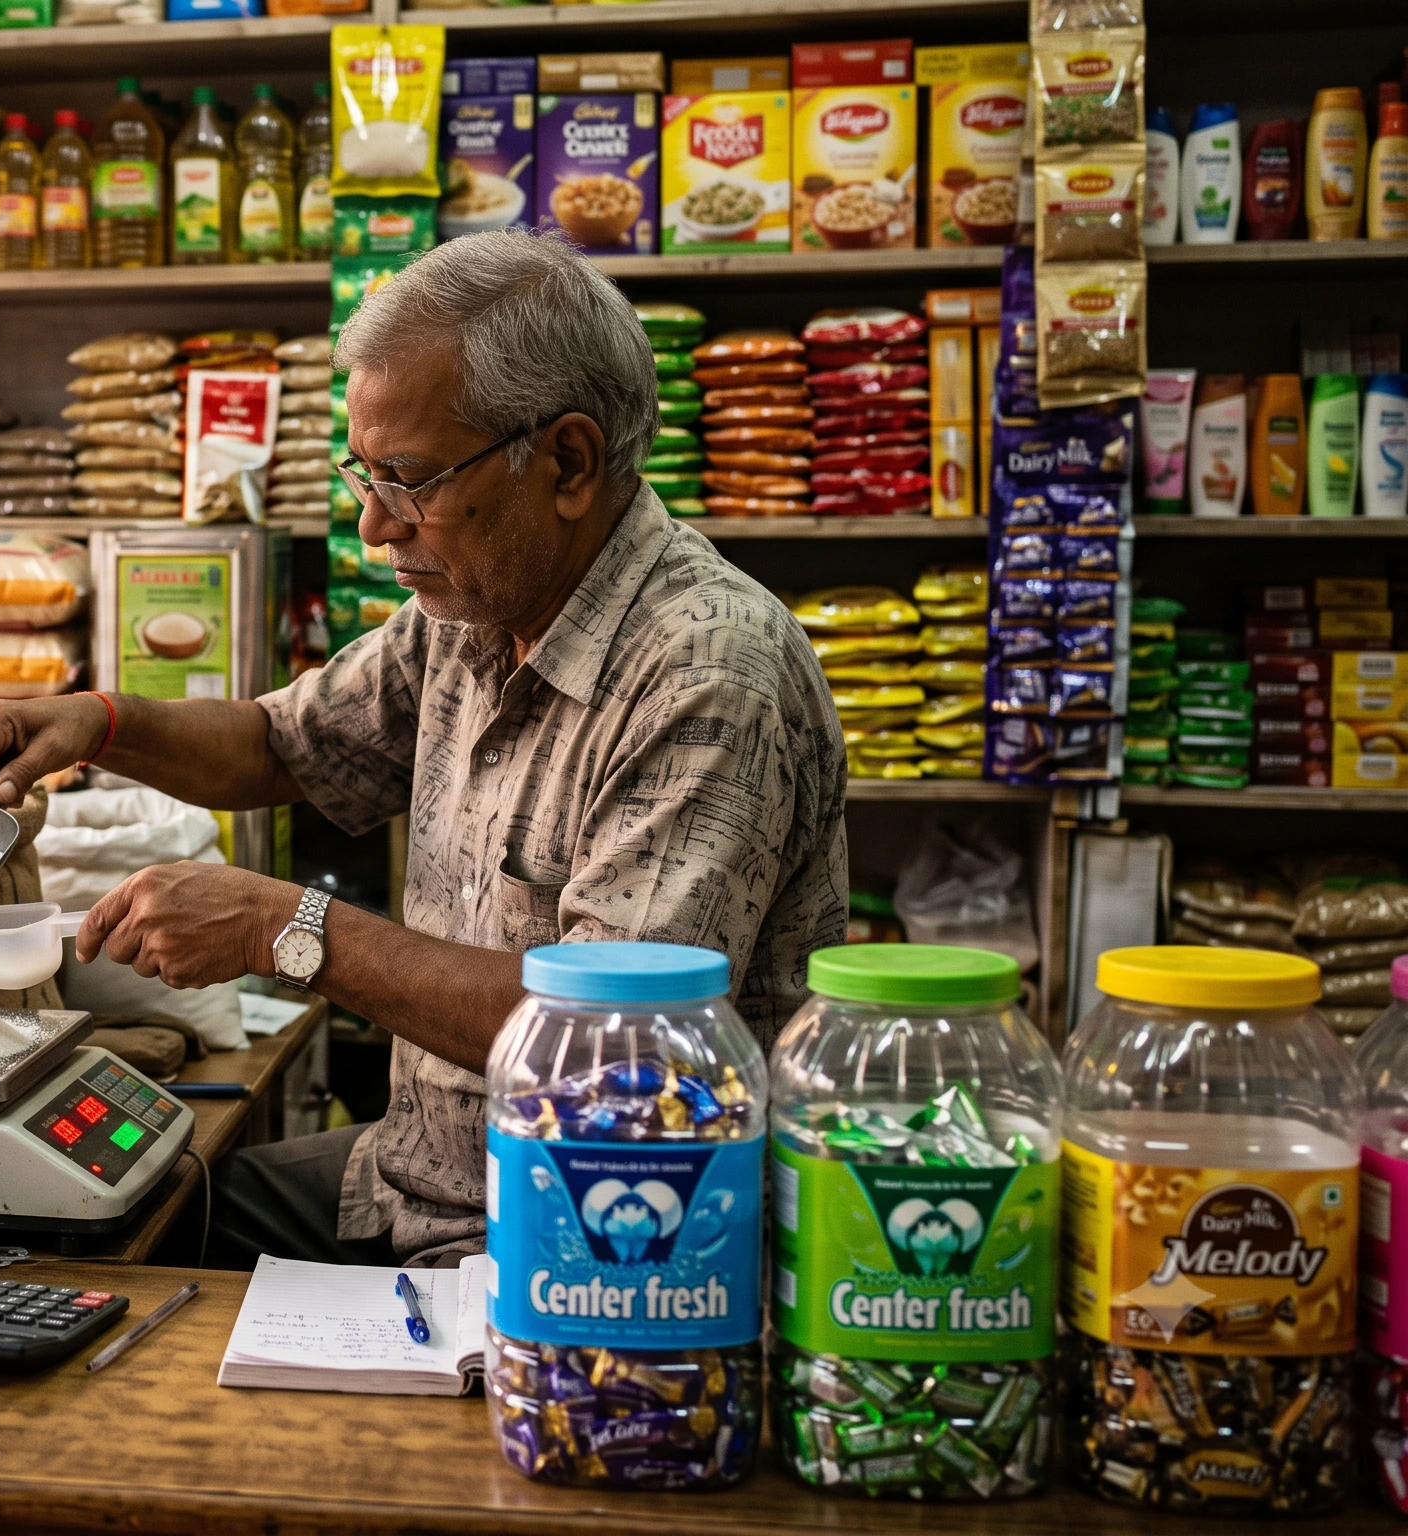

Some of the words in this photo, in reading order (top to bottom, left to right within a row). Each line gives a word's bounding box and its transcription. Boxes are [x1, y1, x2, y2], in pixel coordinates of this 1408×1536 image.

[1200, 1214, 1243, 1235] Dairy
[1151, 1238, 1327, 1286] Melody
[528, 1268, 638, 1320] Center
[644, 1273, 729, 1321] fresh
[829, 1279, 941, 1331] Center
[947, 1283, 1032, 1330] fresh
